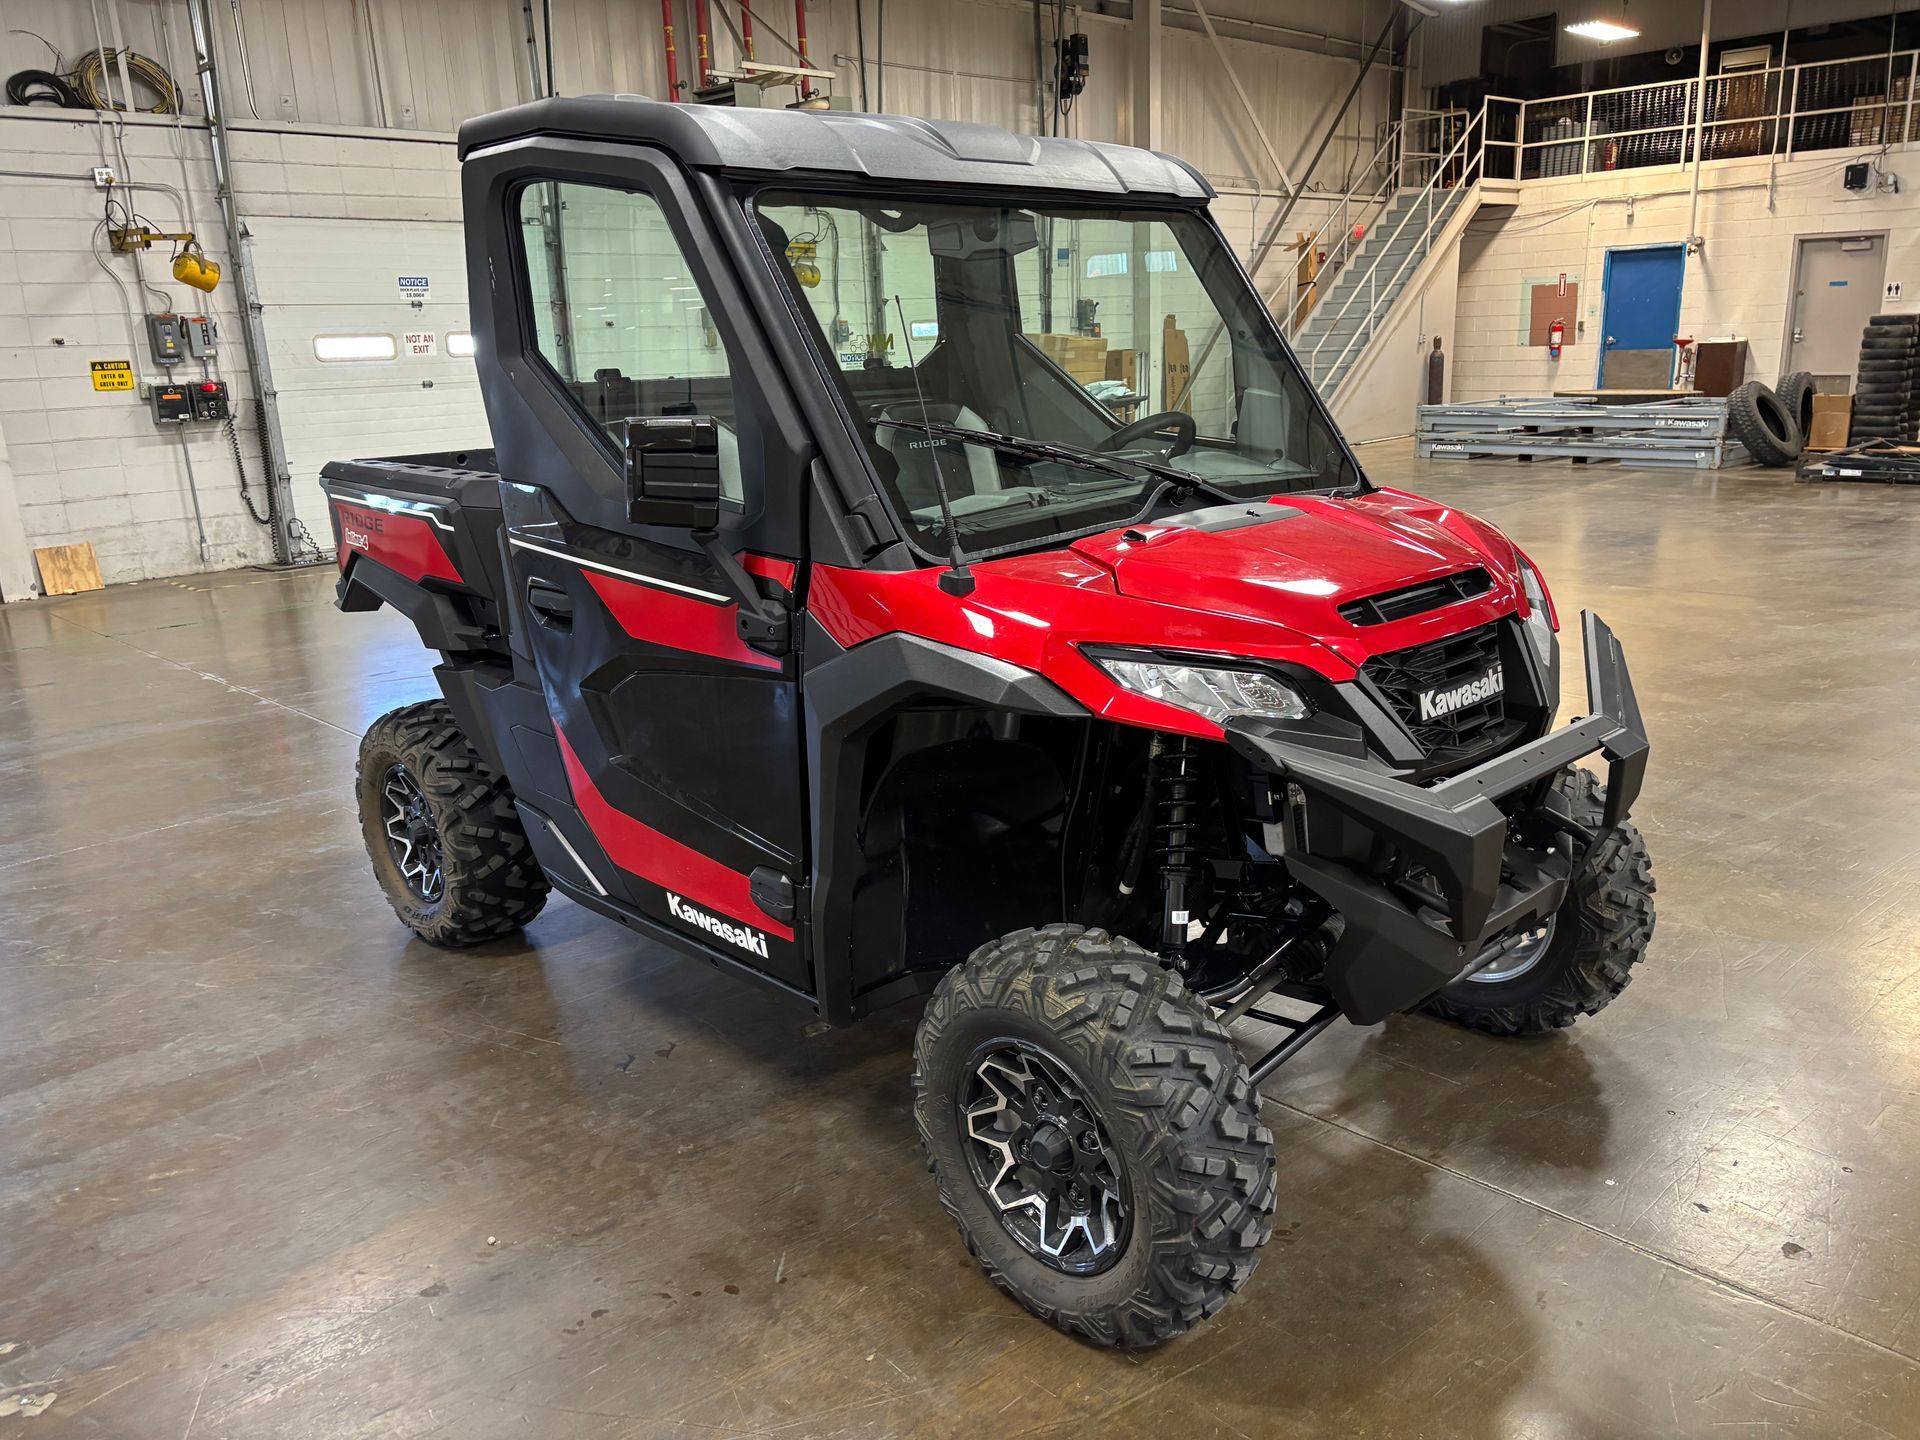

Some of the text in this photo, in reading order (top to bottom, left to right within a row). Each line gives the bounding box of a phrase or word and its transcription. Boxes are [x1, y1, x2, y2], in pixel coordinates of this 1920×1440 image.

[400, 278, 427, 286] NOTICE
[405, 334, 434, 343] NOT AN
[555, 334, 563, 347] 2
[413, 345, 429, 354] EXIT
[841, 354, 866, 362] NOTICE
[103, 362, 128, 370] CAUTION
[1667, 419, 1709, 428] Kawasaki
[909, 438, 948, 449] RIDGE
[1431, 443, 1465, 451] Kawasaki
[1420, 665, 1504, 721] Kawasaki
[666, 891, 769, 959] Kawasaki
